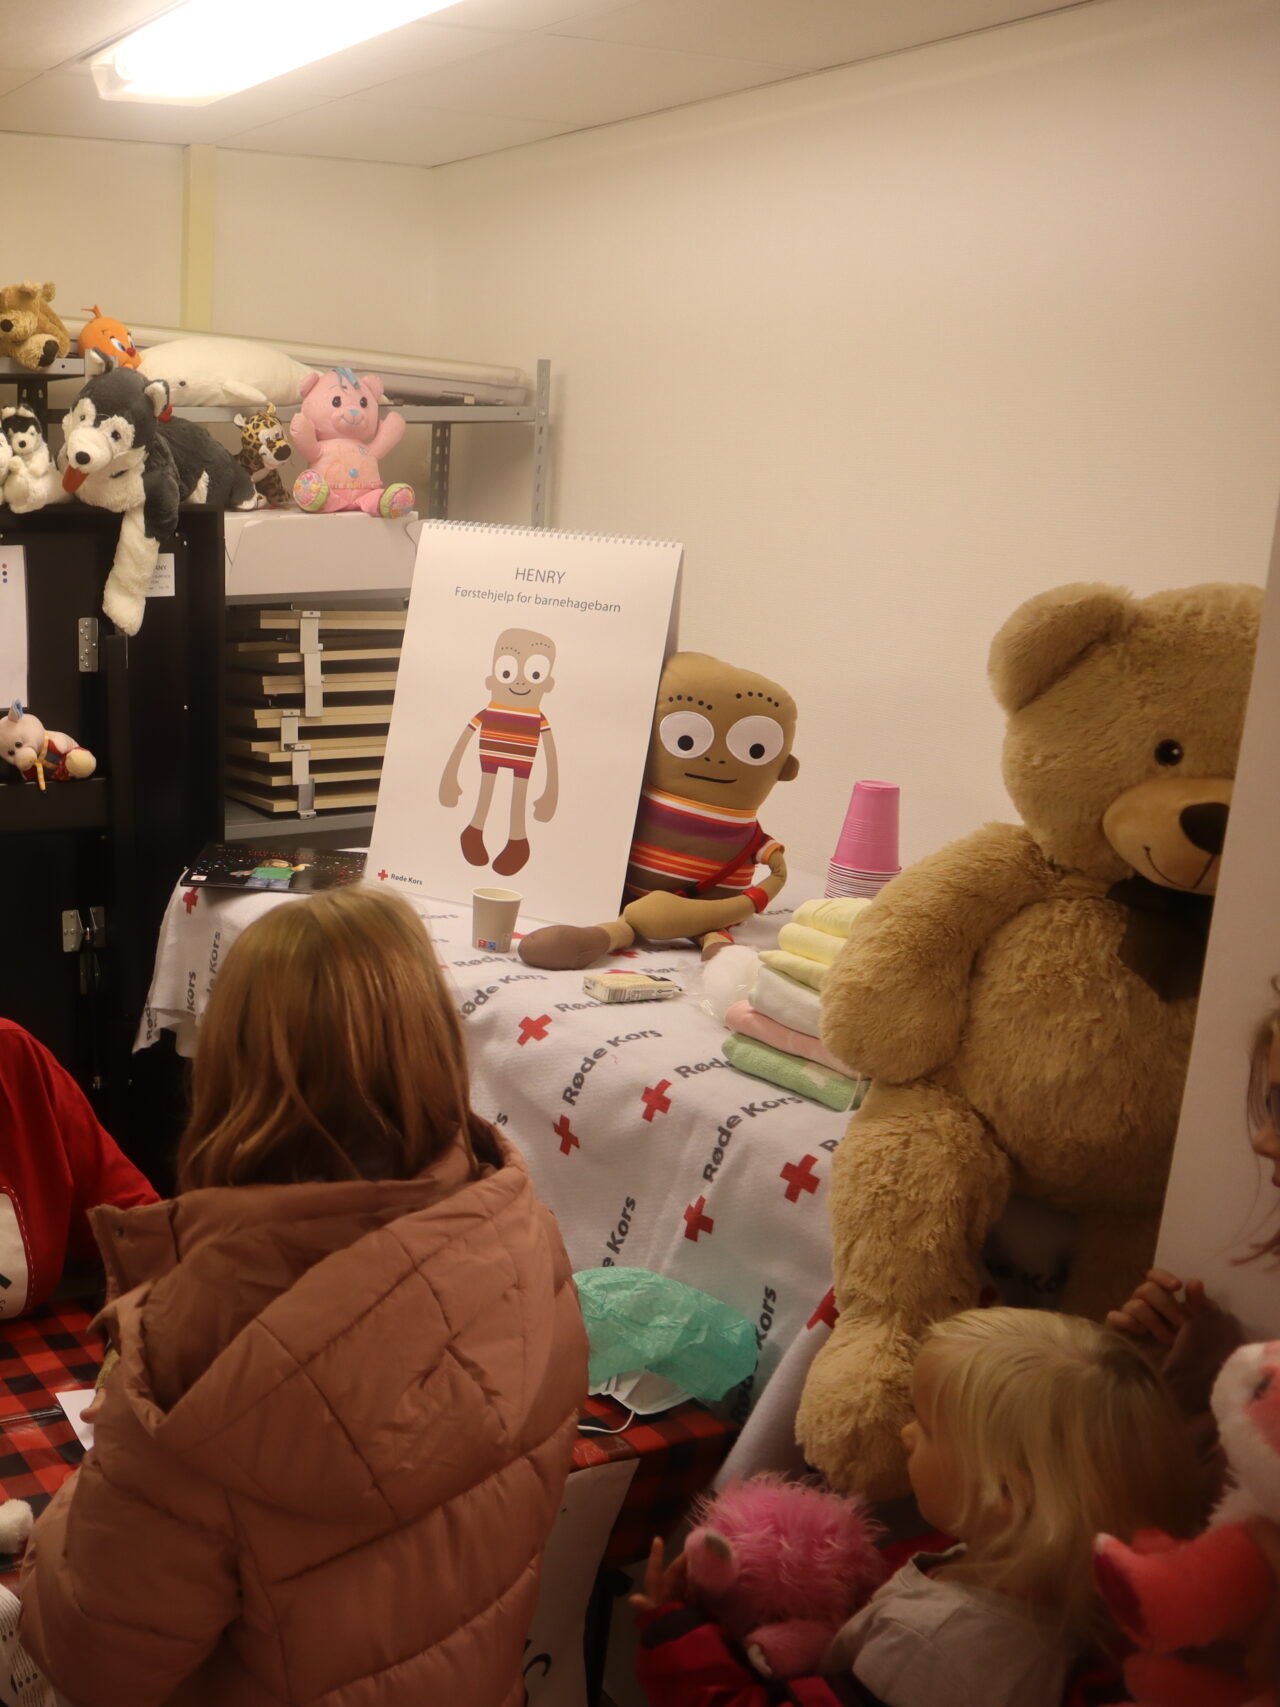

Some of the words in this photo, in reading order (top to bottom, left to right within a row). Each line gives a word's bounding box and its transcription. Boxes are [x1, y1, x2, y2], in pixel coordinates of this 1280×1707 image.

[515, 567, 566, 585] HENRY
[454, 586, 514, 604] Førstehjelp
[516, 592, 533, 605] for
[534, 593, 621, 613] barnehagebarn
[391, 873, 407, 882] Røde
[408, 877, 423, 886] Kors
[209, 930, 221, 974] Kors
[452, 955, 505, 968] Røde
[187, 970, 197, 1013] Kors
[498, 974, 548, 985] Kors
[562, 1048, 608, 1106] Røde
[606, 1029, 663, 1048] Kors
[703, 1115, 743, 1183] Røde
[740, 1096, 803, 1118] Kors
[606, 1196, 637, 1255] Kors
